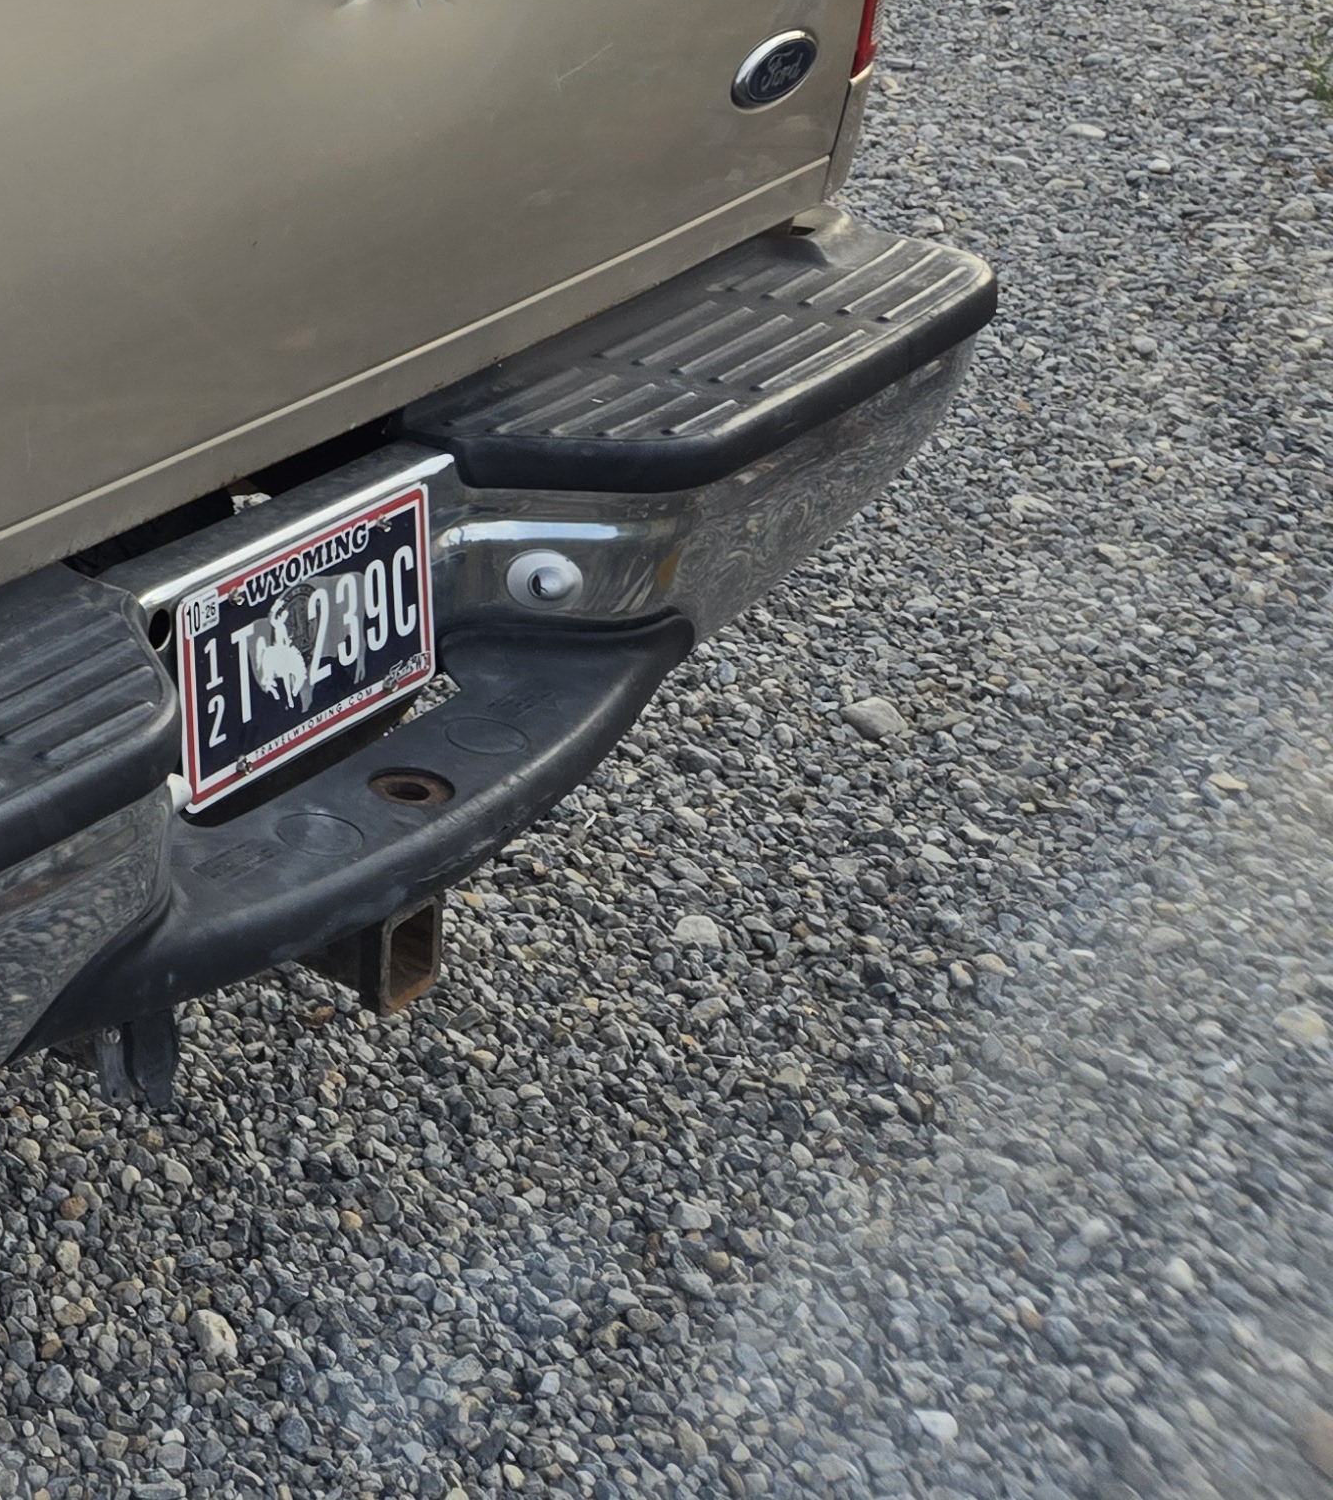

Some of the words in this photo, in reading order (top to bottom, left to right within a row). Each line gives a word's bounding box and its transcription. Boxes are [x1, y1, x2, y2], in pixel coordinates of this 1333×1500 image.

[760, 48, 805, 92] Ford
[244, 524, 368, 603] WYOMING
[254, 687, 374, 759] TRAVELWYOMING.COM
